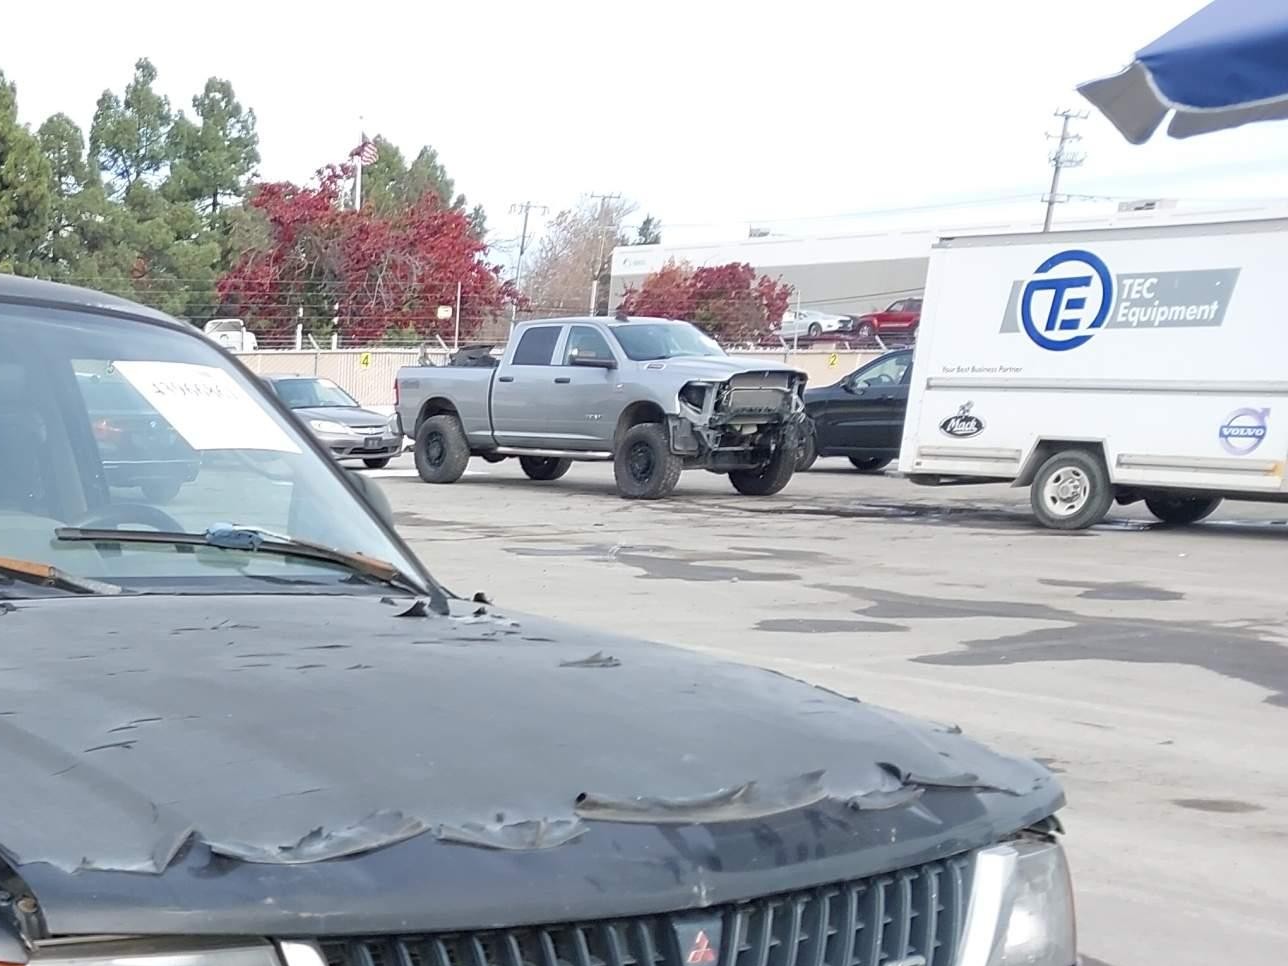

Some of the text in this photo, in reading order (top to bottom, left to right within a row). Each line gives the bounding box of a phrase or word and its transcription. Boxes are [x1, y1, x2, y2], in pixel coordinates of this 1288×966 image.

[1121, 278, 1158, 299] TEC
[1116, 302, 1219, 327] Equipment
[360, 354, 369, 367] 4
[830, 353, 837, 366] 2
[957, 365, 970, 373] Best
[971, 365, 998, 373] Business
[999, 365, 1023, 373] Partner
[946, 418, 978, 433] Mack
[1222, 427, 1264, 436] VOLVO
